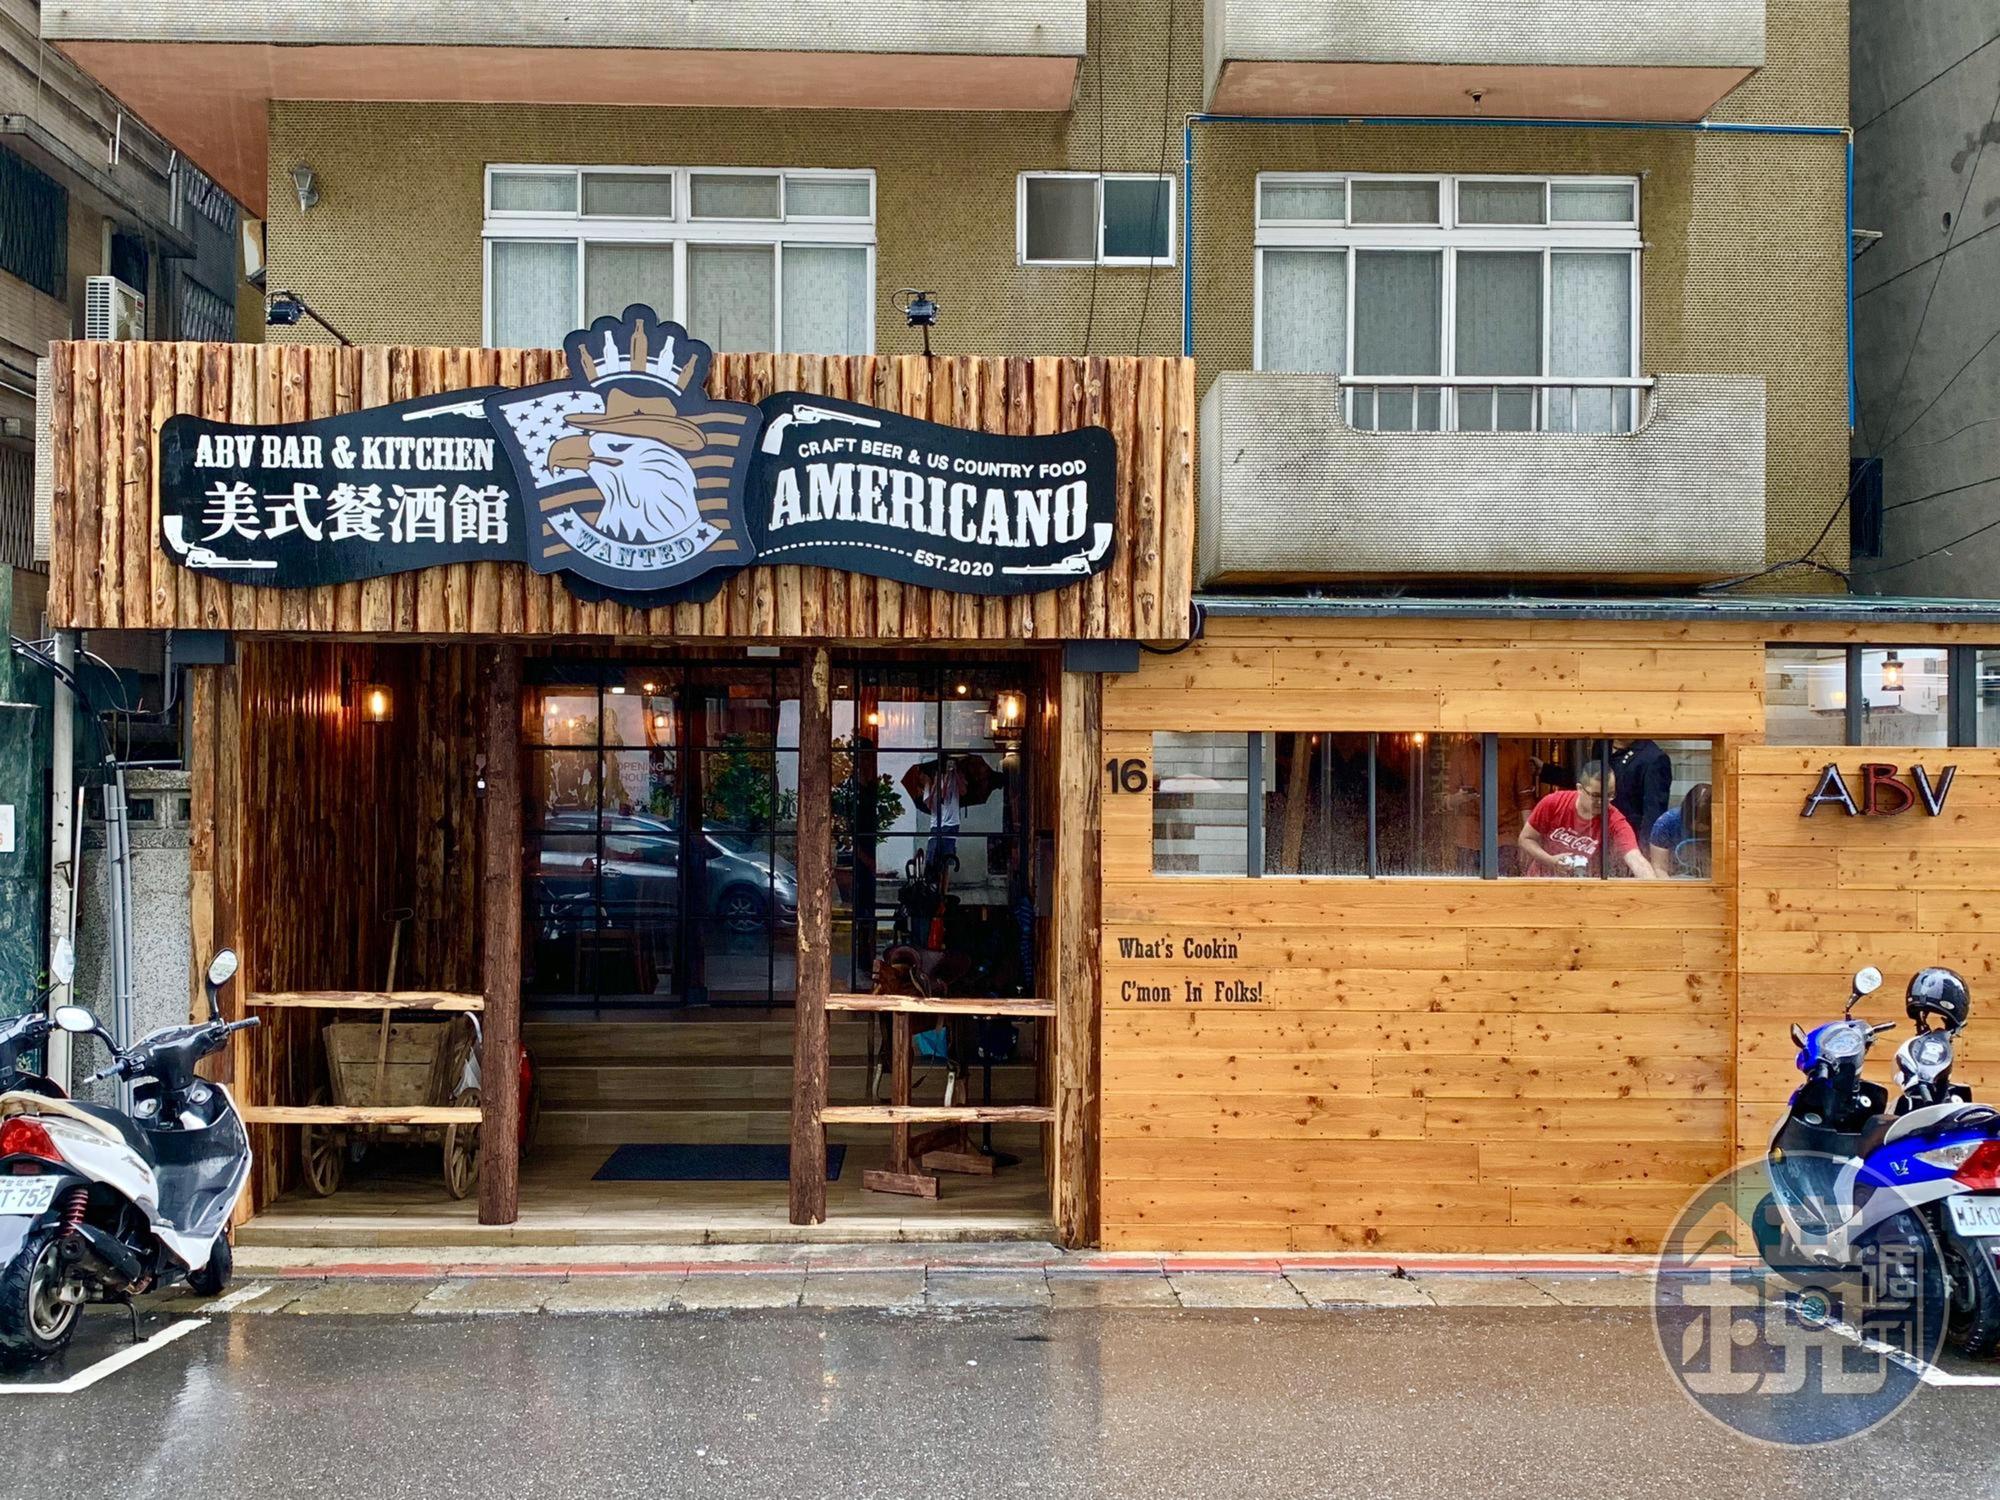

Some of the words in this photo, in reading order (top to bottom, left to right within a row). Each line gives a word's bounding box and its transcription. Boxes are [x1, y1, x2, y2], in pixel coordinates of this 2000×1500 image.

[194, 434, 255, 469] ABV
[261, 434, 323, 469] BAR
[332, 434, 357, 469] &
[361, 436, 495, 472] KITCHEN
[798, 438, 857, 458] CRAFT
[861, 439, 903, 460] BEER
[908, 449, 921, 465] &
[927, 452, 949, 471] US
[953, 457, 1036, 479] COUNTRY
[1039, 459, 1087, 479] FOOD
[201, 480, 509, 544] 美式餐酒館
[768, 462, 1088, 548] AMERICANO
[575, 529, 695, 567] WANTED
[913, 549, 994, 577] EST.2020
[1106, 758, 1148, 794] 16
[1800, 762, 1957, 817] ABV
[1118, 937, 1173, 959] What's
[1183, 933, 1241, 959] Cookin'
[1121, 980, 1171, 1002] C'mon
[1185, 981, 1202, 1002] In
[1214, 980, 1262, 1002] Folks!
